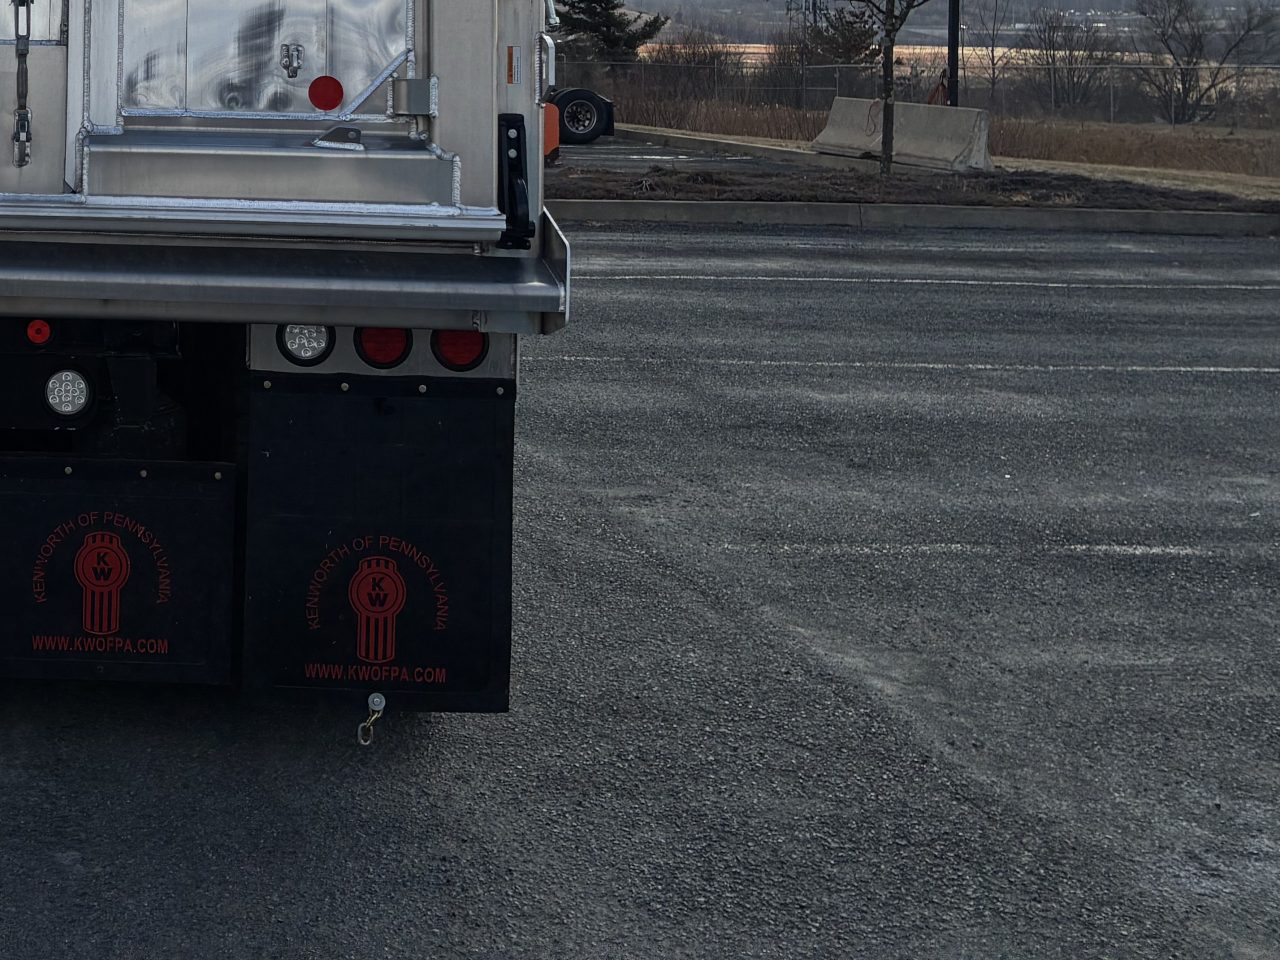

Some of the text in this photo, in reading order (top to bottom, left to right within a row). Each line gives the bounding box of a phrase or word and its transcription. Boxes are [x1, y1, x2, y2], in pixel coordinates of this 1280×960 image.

[32, 511, 171, 604] KENWORTH OF PENNSYLVANIA
[96, 551, 109, 566] K
[92, 567, 113, 581] W
[306, 535, 449, 631] KENWORTH OF PENNSYLVANIA
[372, 576, 384, 591] K
[367, 592, 388, 607] W
[32, 635, 168, 654] WWW.KWOFPA.COM
[304, 663, 446, 684] WWW.KWOFPA.COM
